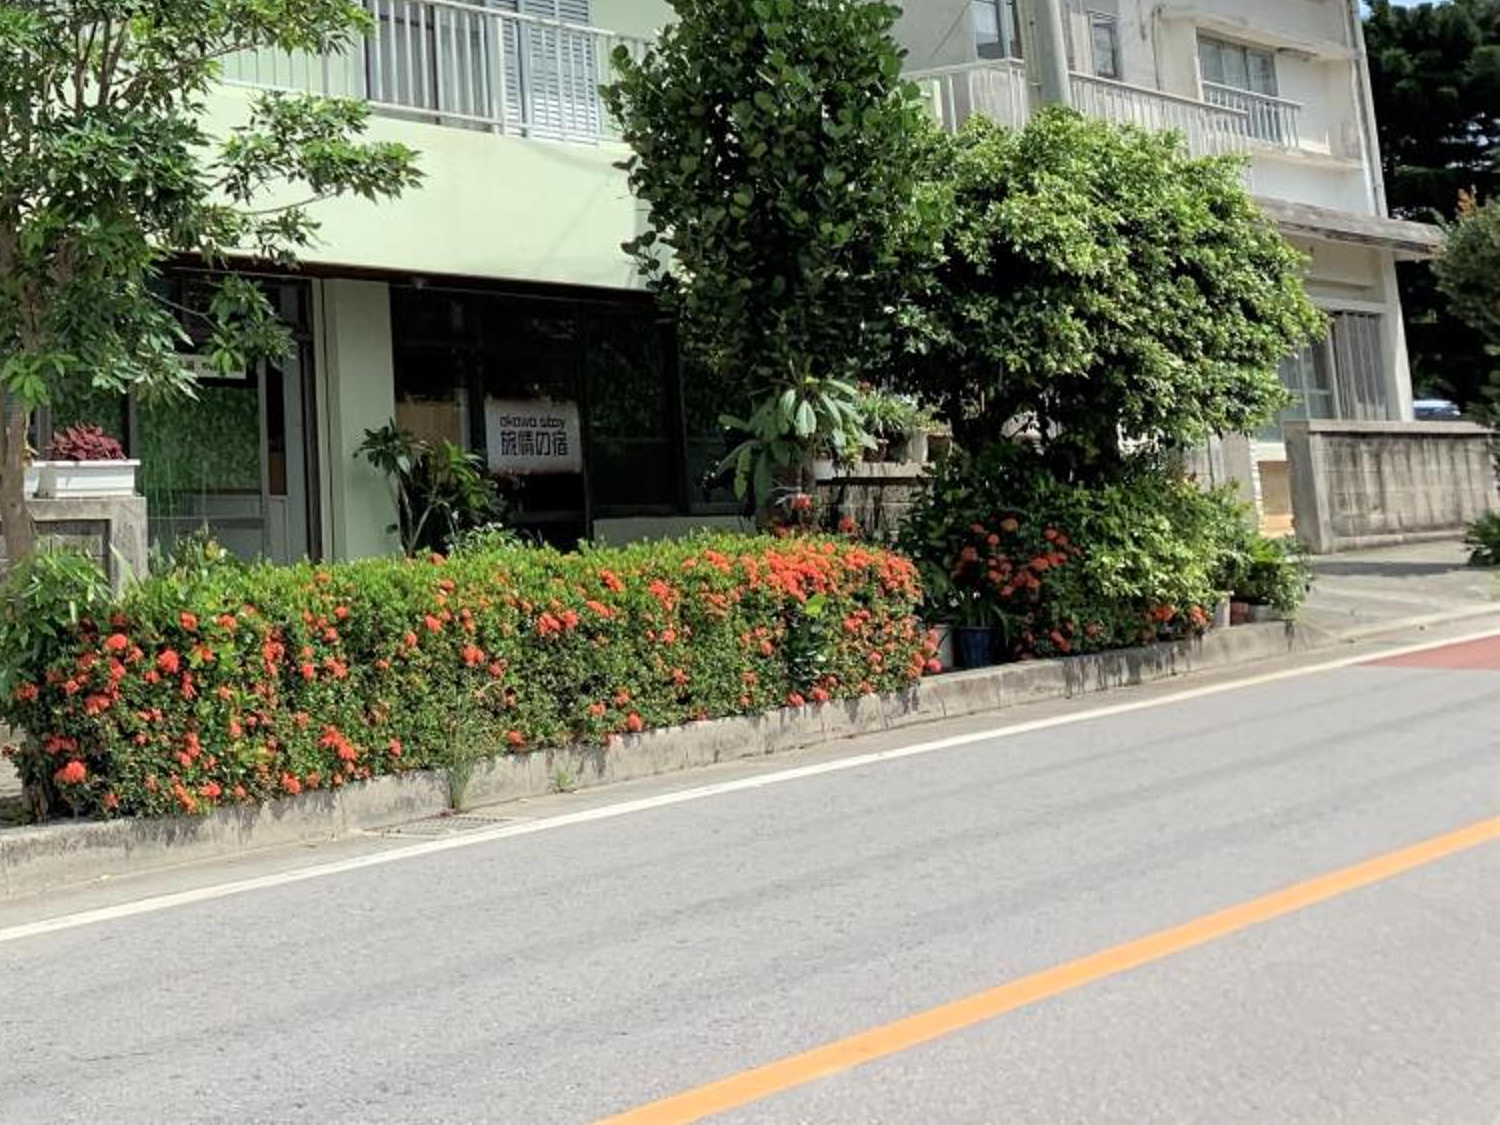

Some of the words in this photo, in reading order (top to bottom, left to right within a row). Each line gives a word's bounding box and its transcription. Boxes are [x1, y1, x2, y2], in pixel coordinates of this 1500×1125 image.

[539, 414, 565, 429] stay
[500, 430, 568, 456] 旅情の宿
